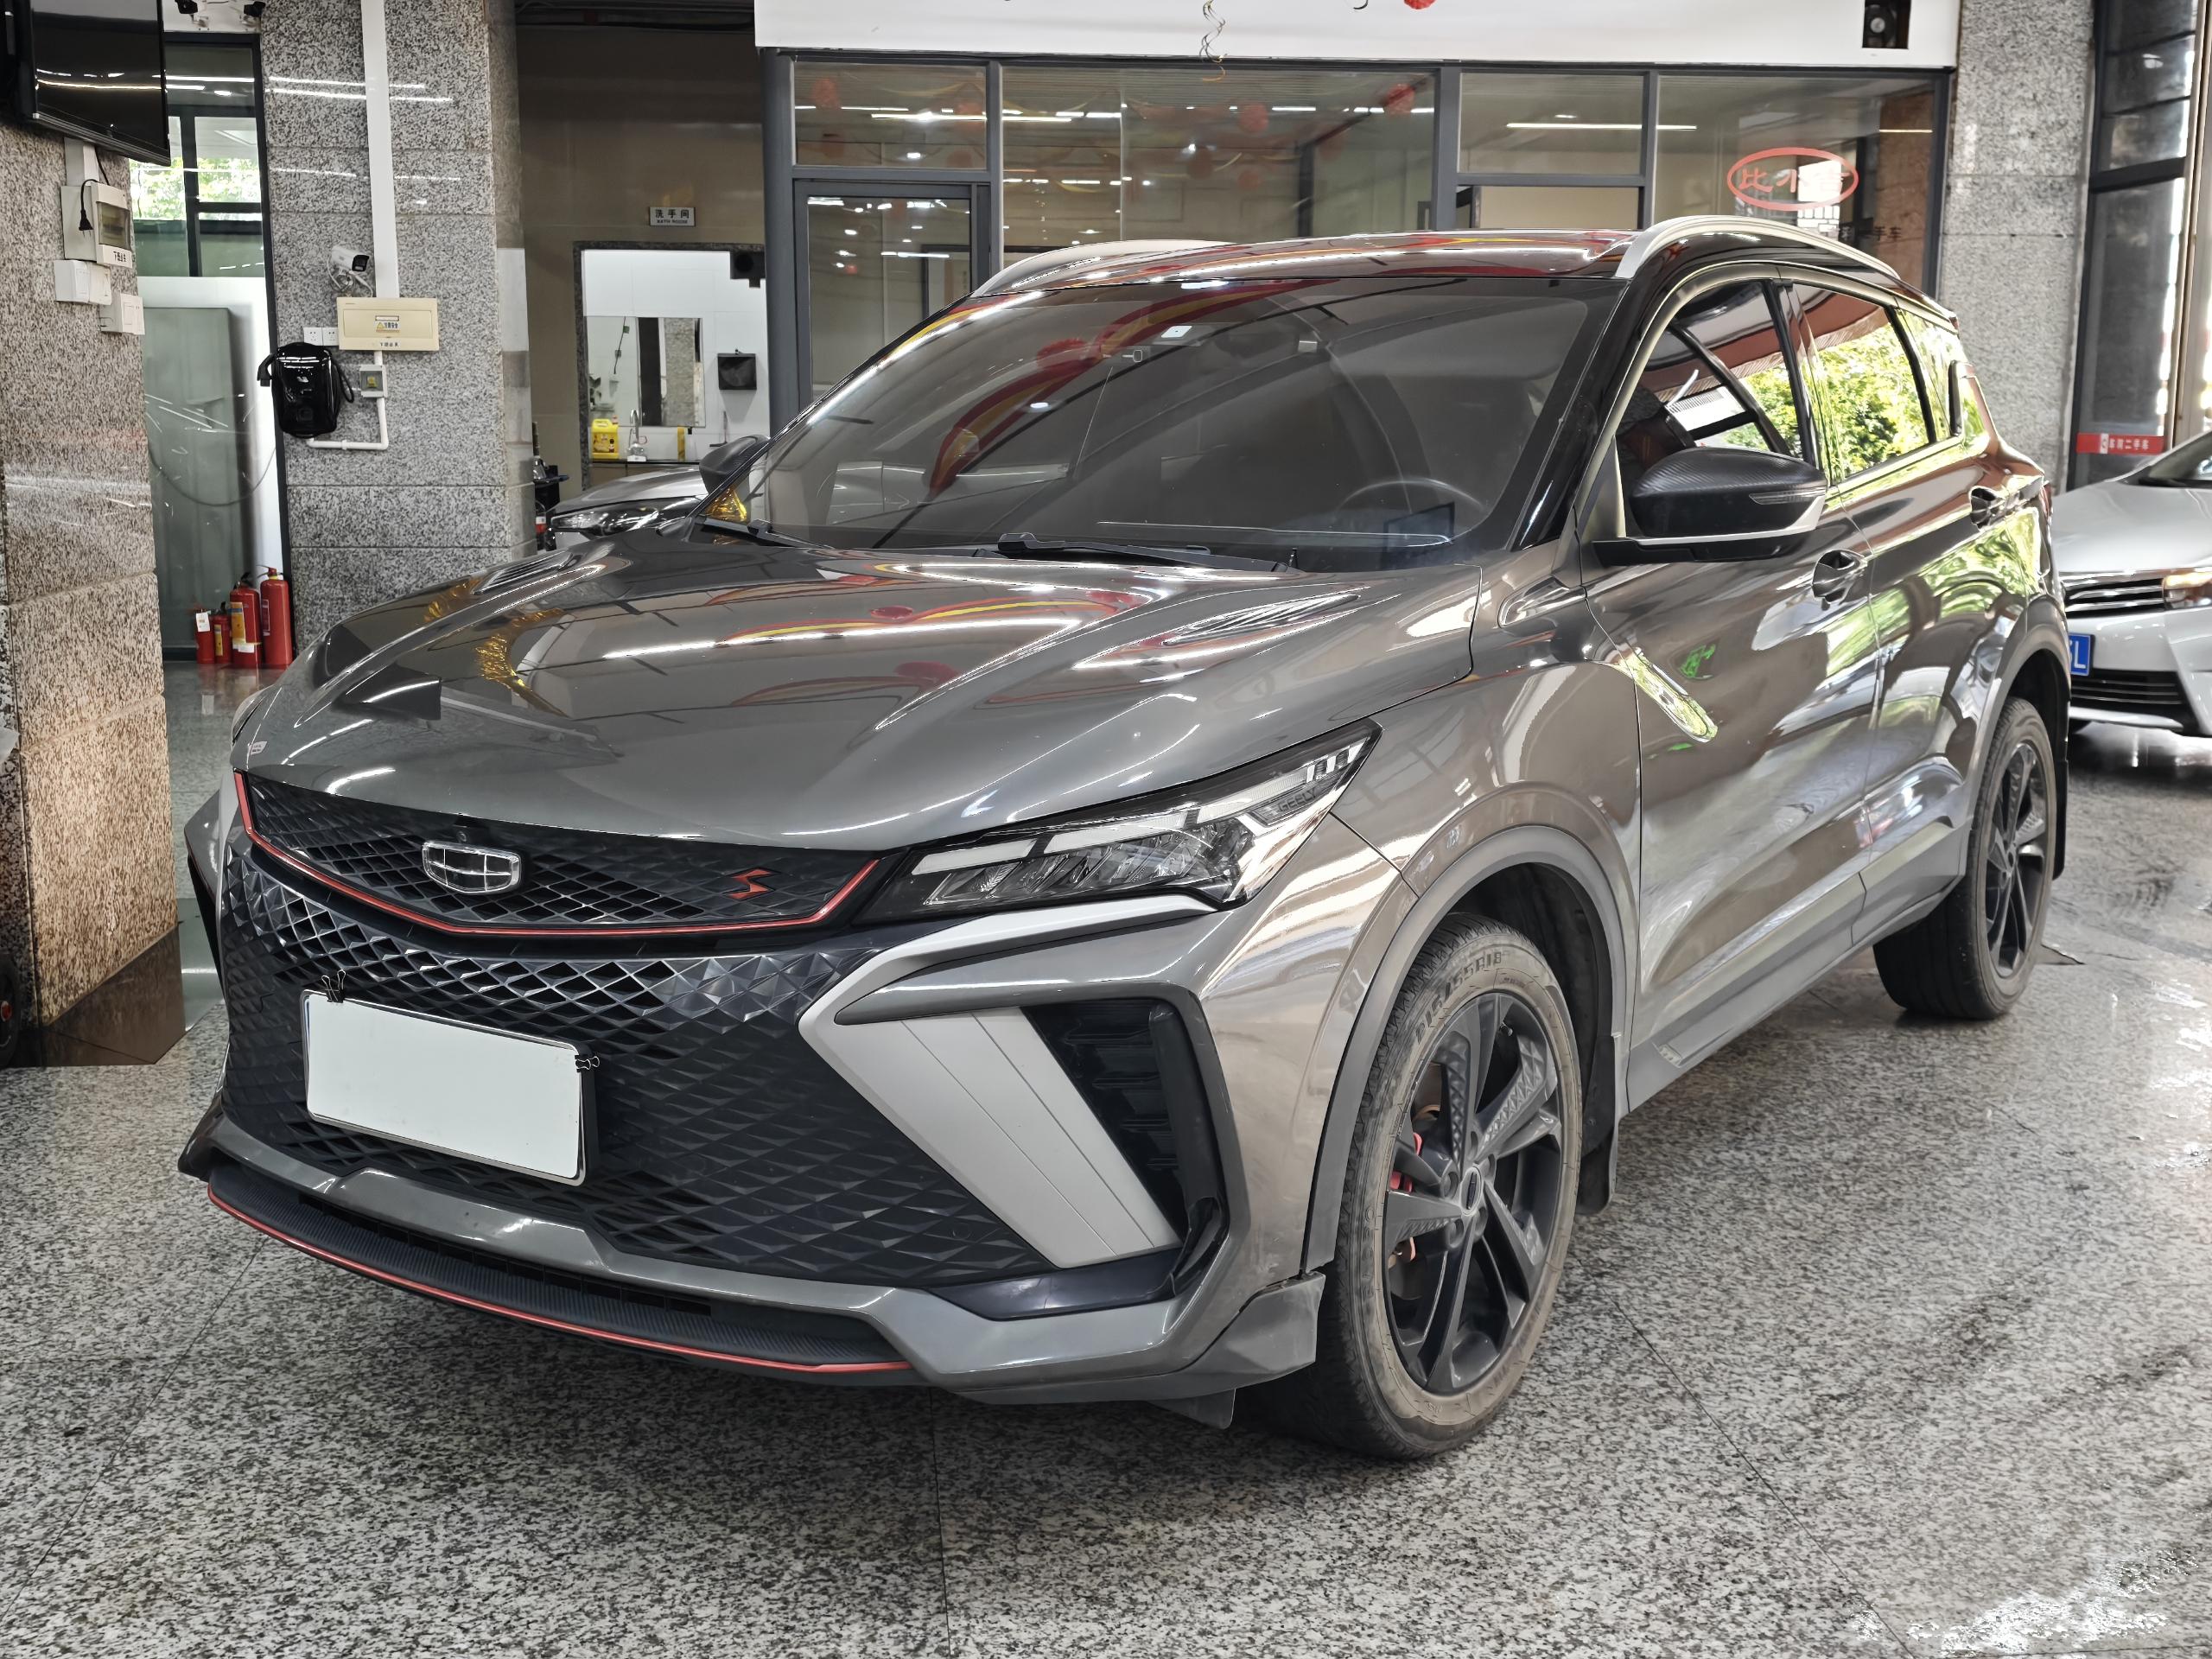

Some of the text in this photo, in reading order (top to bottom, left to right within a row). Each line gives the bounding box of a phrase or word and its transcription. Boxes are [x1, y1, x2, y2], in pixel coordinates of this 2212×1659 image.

[655, 209, 690, 219] 洗手间
[1279, 787, 1316, 812] GEELY
